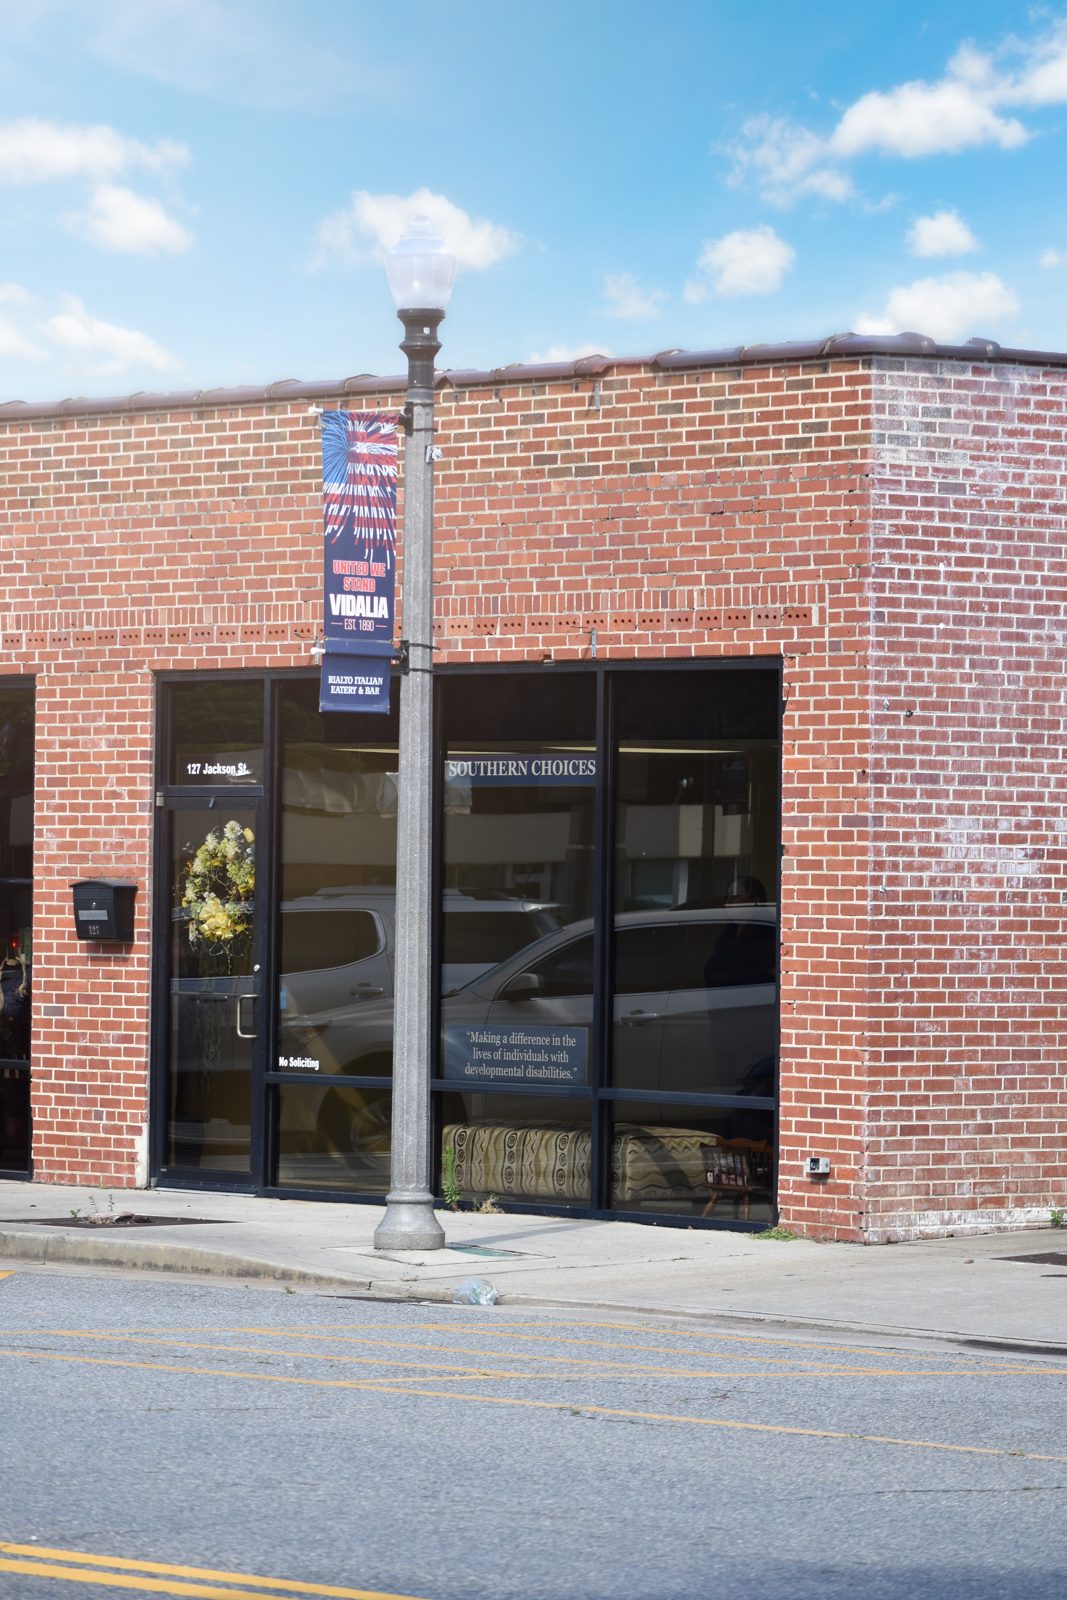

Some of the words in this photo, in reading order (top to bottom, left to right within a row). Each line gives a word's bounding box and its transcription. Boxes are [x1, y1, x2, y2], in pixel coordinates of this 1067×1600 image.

[333, 560, 368, 576] UNITED
[370, 562, 386, 577] WE
[343, 576, 376, 592] STAND
[329, 593, 389, 619] VIDALIA
[359, 619, 375, 631] 1890
[328, 675, 353, 684] RIALTO
[354, 676, 383, 685] ITALIAN
[331, 685, 357, 694] EATERY
[358, 686, 363, 695] &
[365, 686, 380, 695] BAR
[187, 763, 201, 774] 127
[202, 763, 236, 774] Jackson
[448, 760, 528, 777] SOUTHERN
[531, 759, 596, 776] CHOICES
[503, 1035, 507, 1043] a
[509, 1032, 550, 1044] difference
[552, 1034, 560, 1045] in
[563, 1034, 576, 1046] the
[473, 1047, 492, 1059] lives
[493, 1050, 503, 1059] of
[503, 1050, 548, 1062] individuals
[551, 1051, 568, 1062] with
[279, 1057, 288, 1066] No
[289, 1057, 319, 1070] Soliciting
[465, 1063, 524, 1078] developmental
